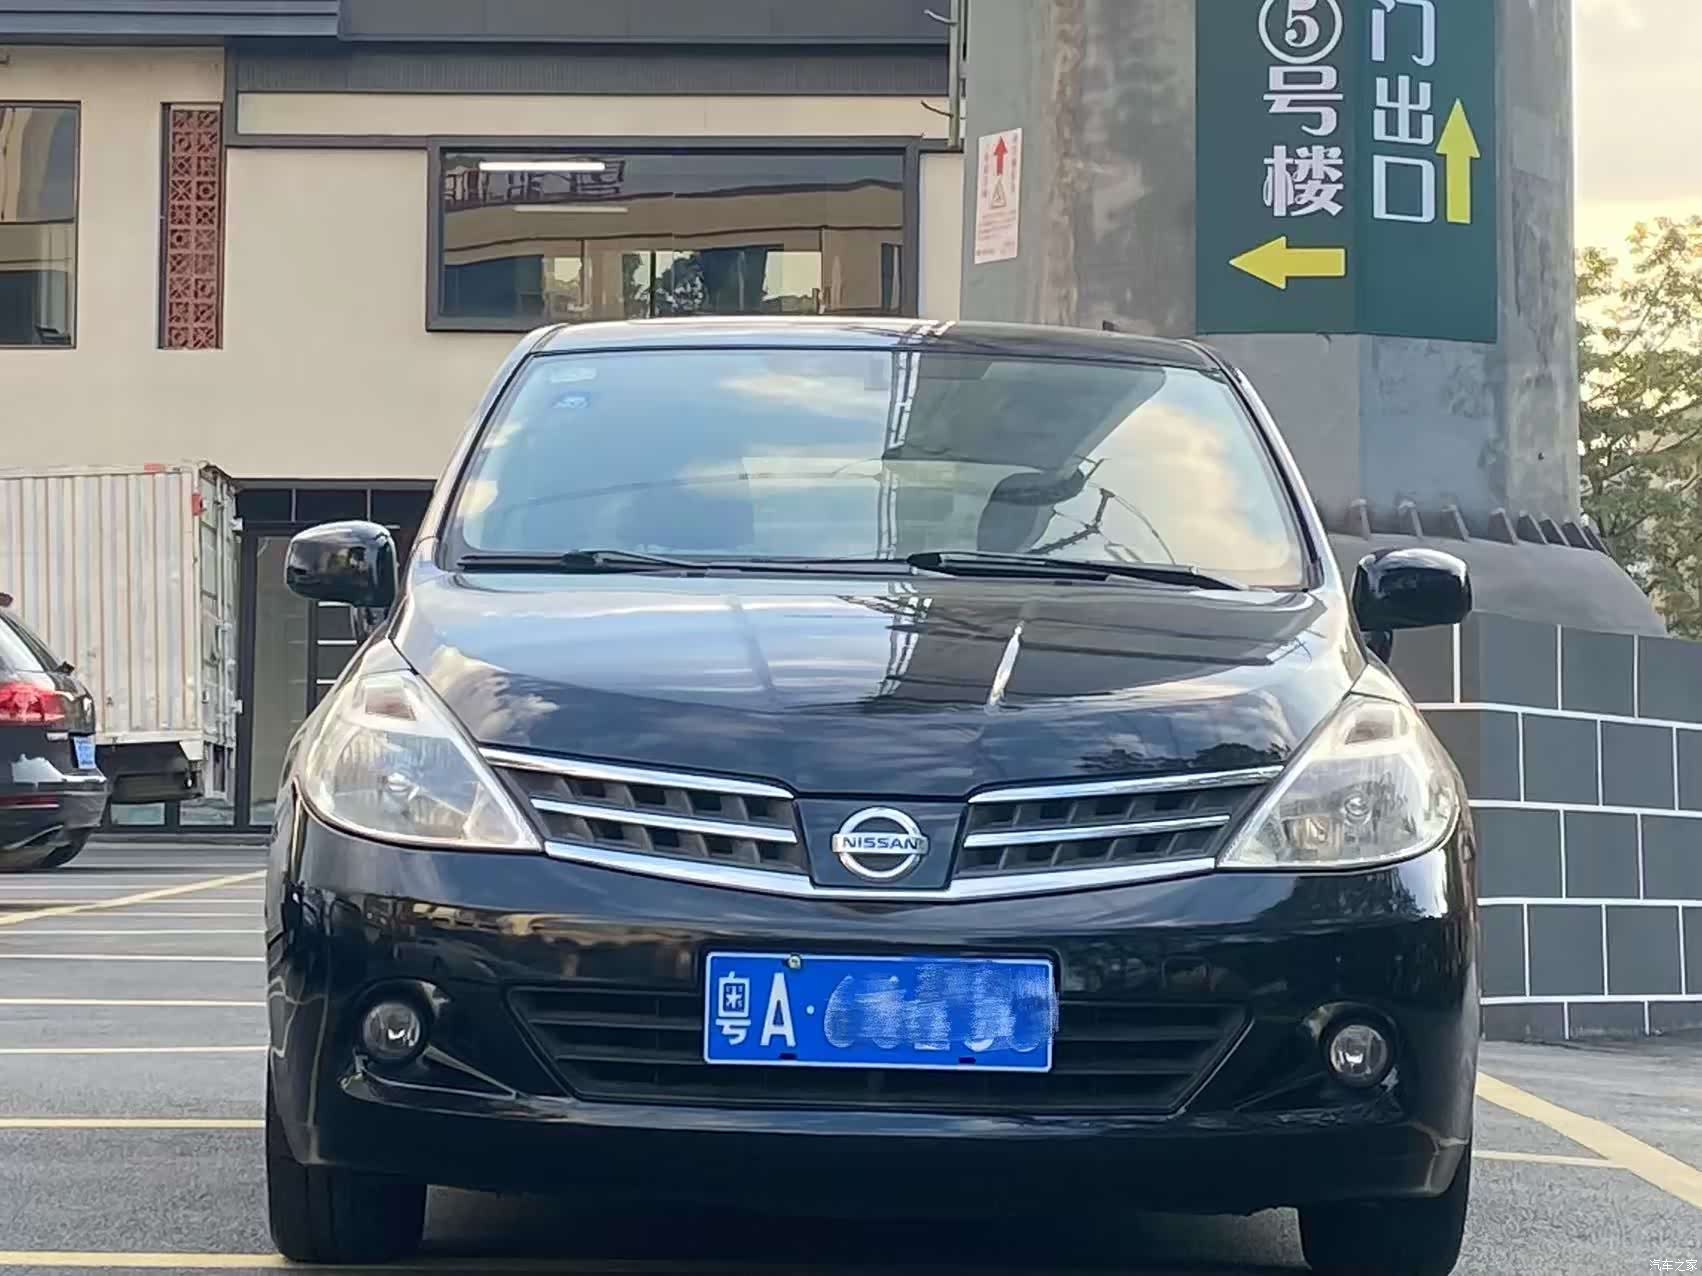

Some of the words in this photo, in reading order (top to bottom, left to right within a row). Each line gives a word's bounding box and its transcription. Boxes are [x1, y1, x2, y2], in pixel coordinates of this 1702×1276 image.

[1372, 0, 1435, 223] 门出口
[842, 836, 918, 850] NISSAN
